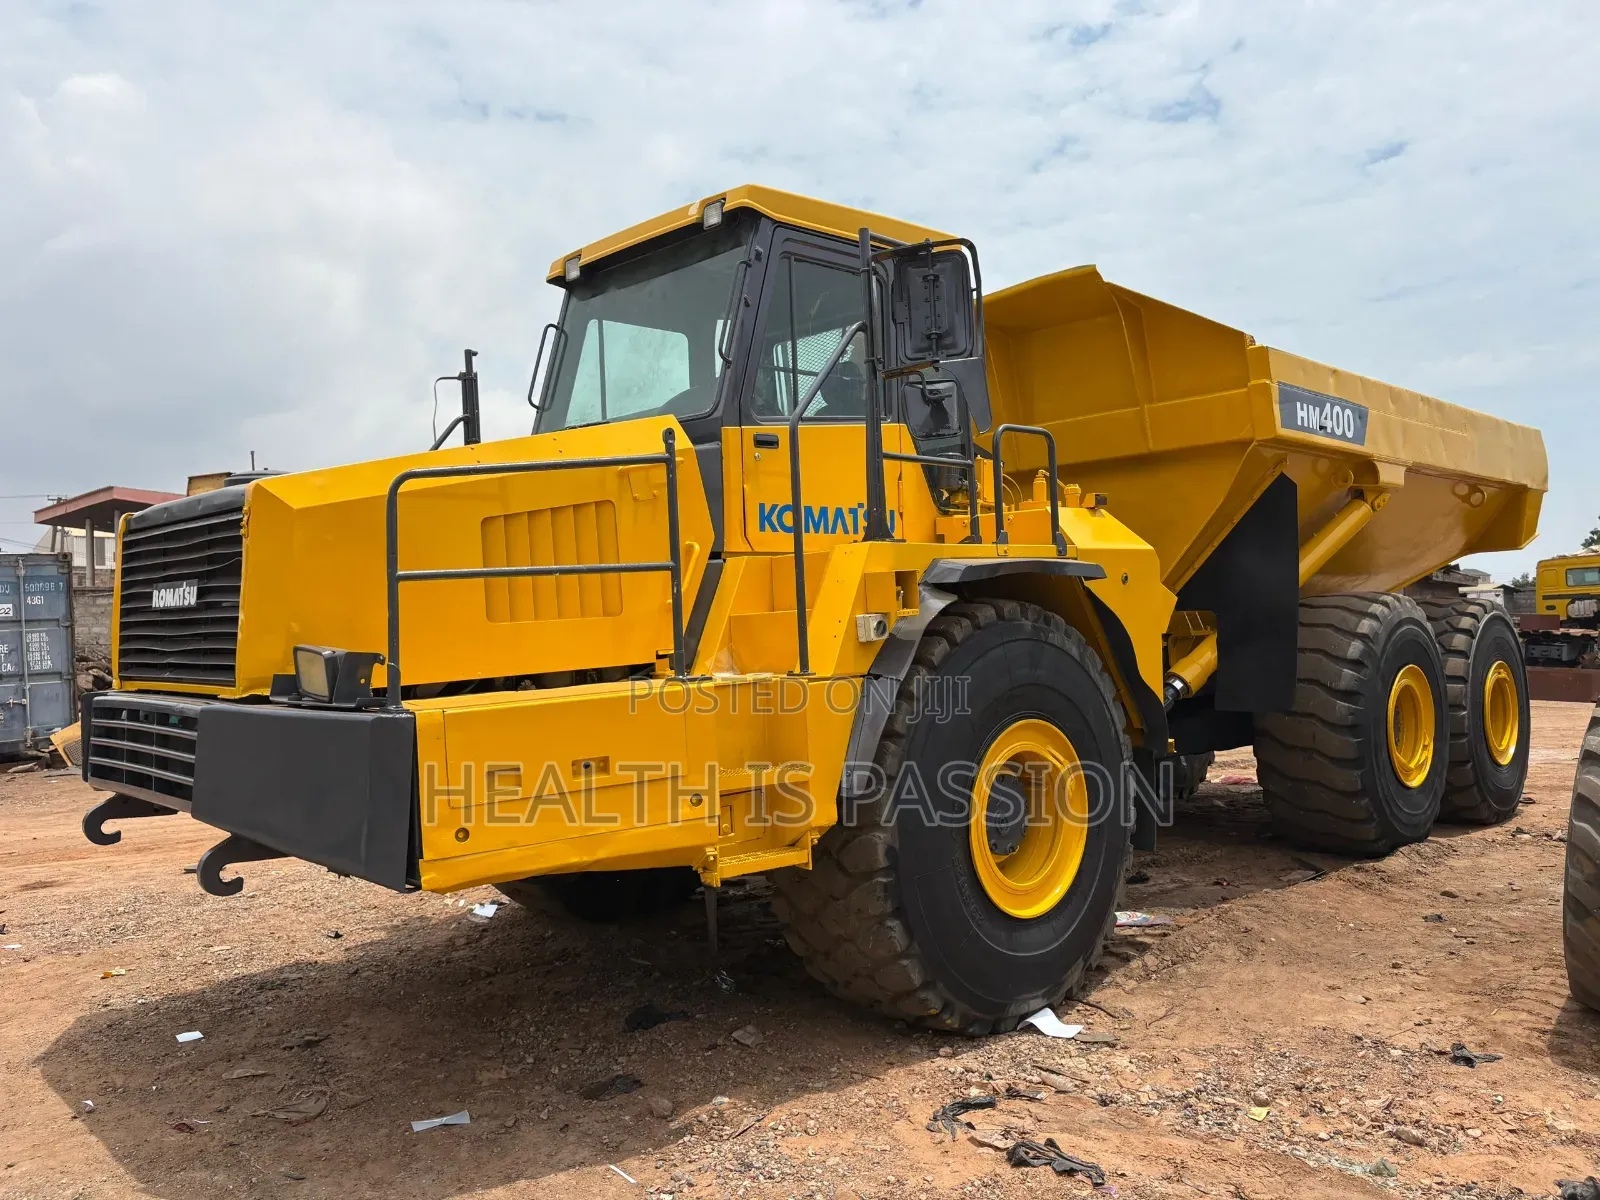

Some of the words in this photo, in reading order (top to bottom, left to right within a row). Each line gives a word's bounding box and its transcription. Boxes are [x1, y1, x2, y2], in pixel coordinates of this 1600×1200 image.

[1296, 401, 1355, 439] HM400
[26, 595, 44, 605] 43G1
[152, 581, 198, 608] KOMATSU
